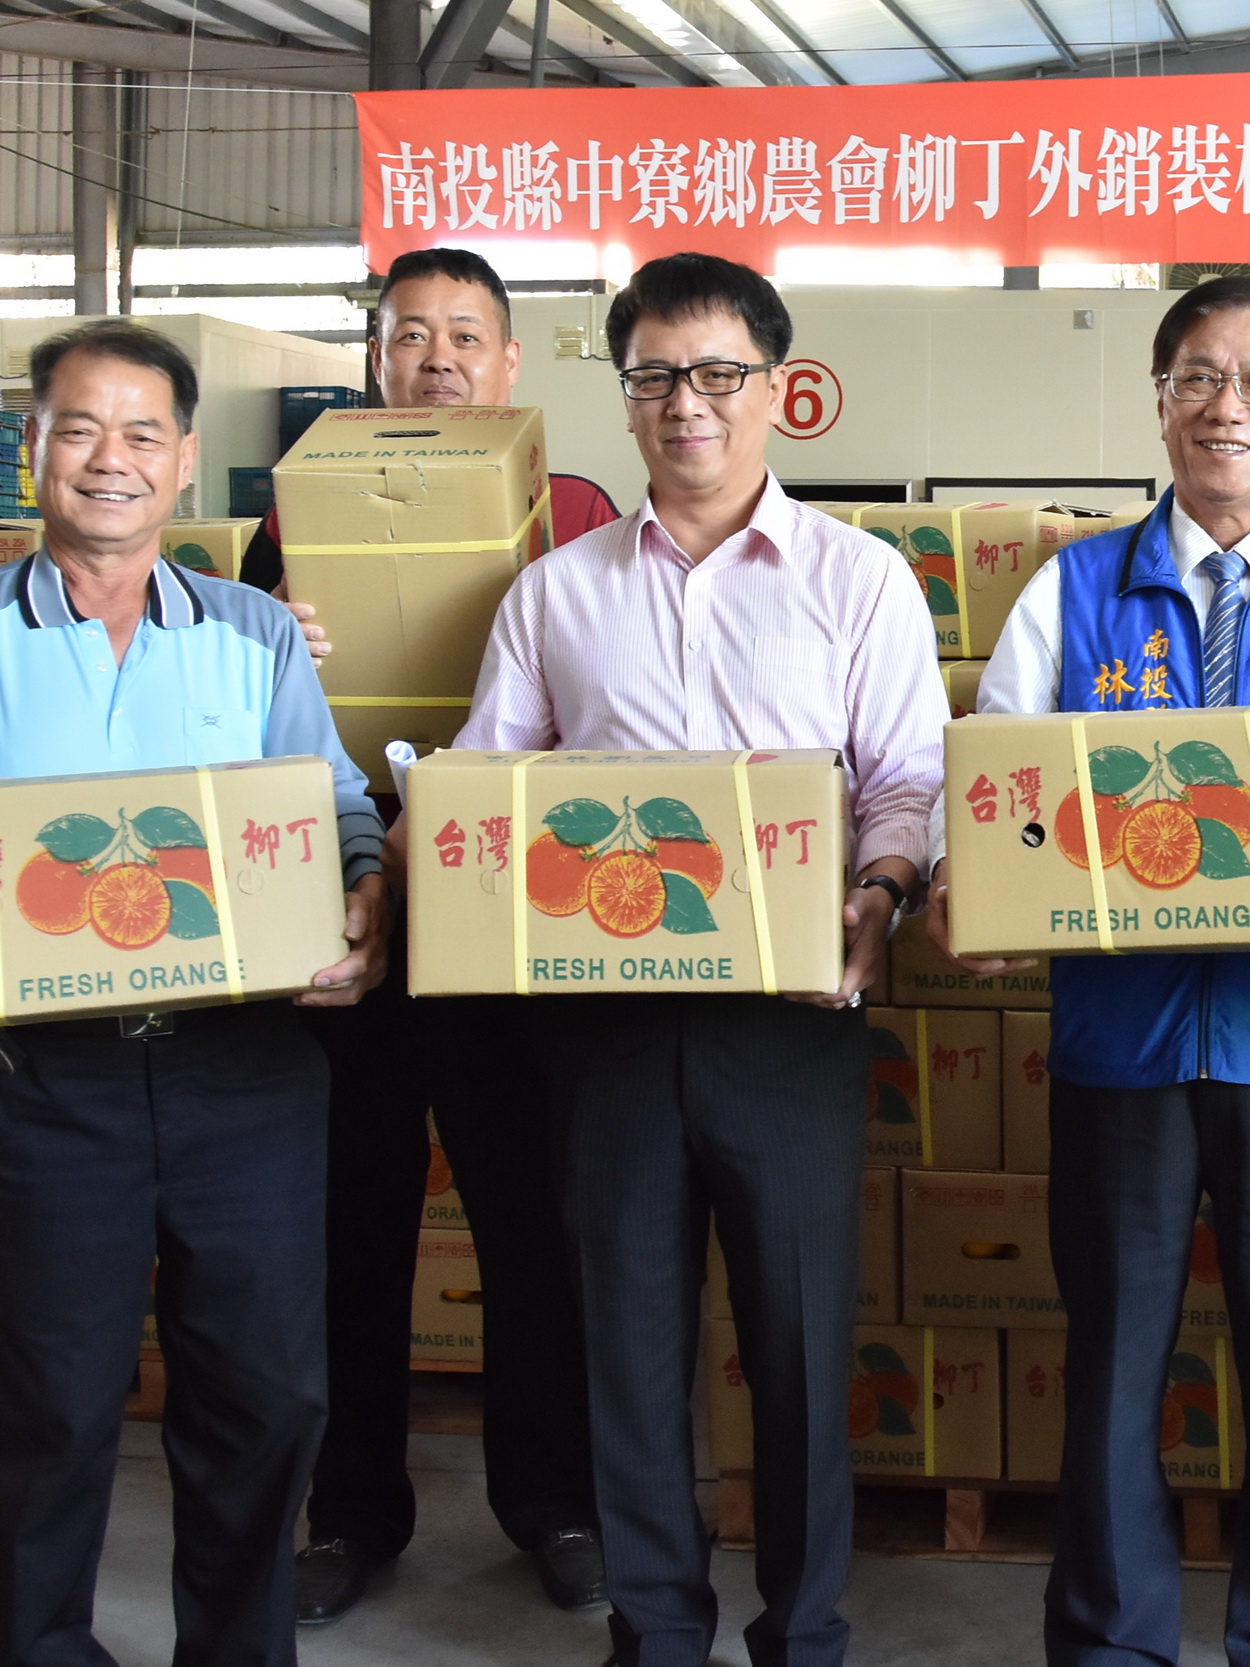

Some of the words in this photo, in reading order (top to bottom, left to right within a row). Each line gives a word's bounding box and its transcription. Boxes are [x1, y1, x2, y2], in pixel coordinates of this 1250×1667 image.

[783, 369, 824, 430] 6
[303, 450, 367, 460] MADE
[374, 449, 397, 458] IN
[403, 448, 488, 458] TAIWAN
[974, 539, 1024, 575] 柳丁
[1093, 659, 1136, 704] 林
[1140, 629, 1172, 710] 南投
[966, 766, 1042, 824] 台灣
[241, 817, 318, 869] 柳丁
[433, 816, 512, 872] 台灣
[1050, 907, 1139, 932] FRESH
[19, 970, 113, 1002] FRESH
[527, 957, 605, 981] RESH
[619, 956, 733, 981] ORANGE
[914, 974, 969, 990] MADE
[975, 976, 994, 991] IN
[932, 1043, 986, 1082] 柳丁
[923, 1293, 977, 1309] MADE
[982, 1295, 1000, 1310] IN
[410, 1333, 455, 1347] MADE
[459, 1335, 475, 1348] IN
